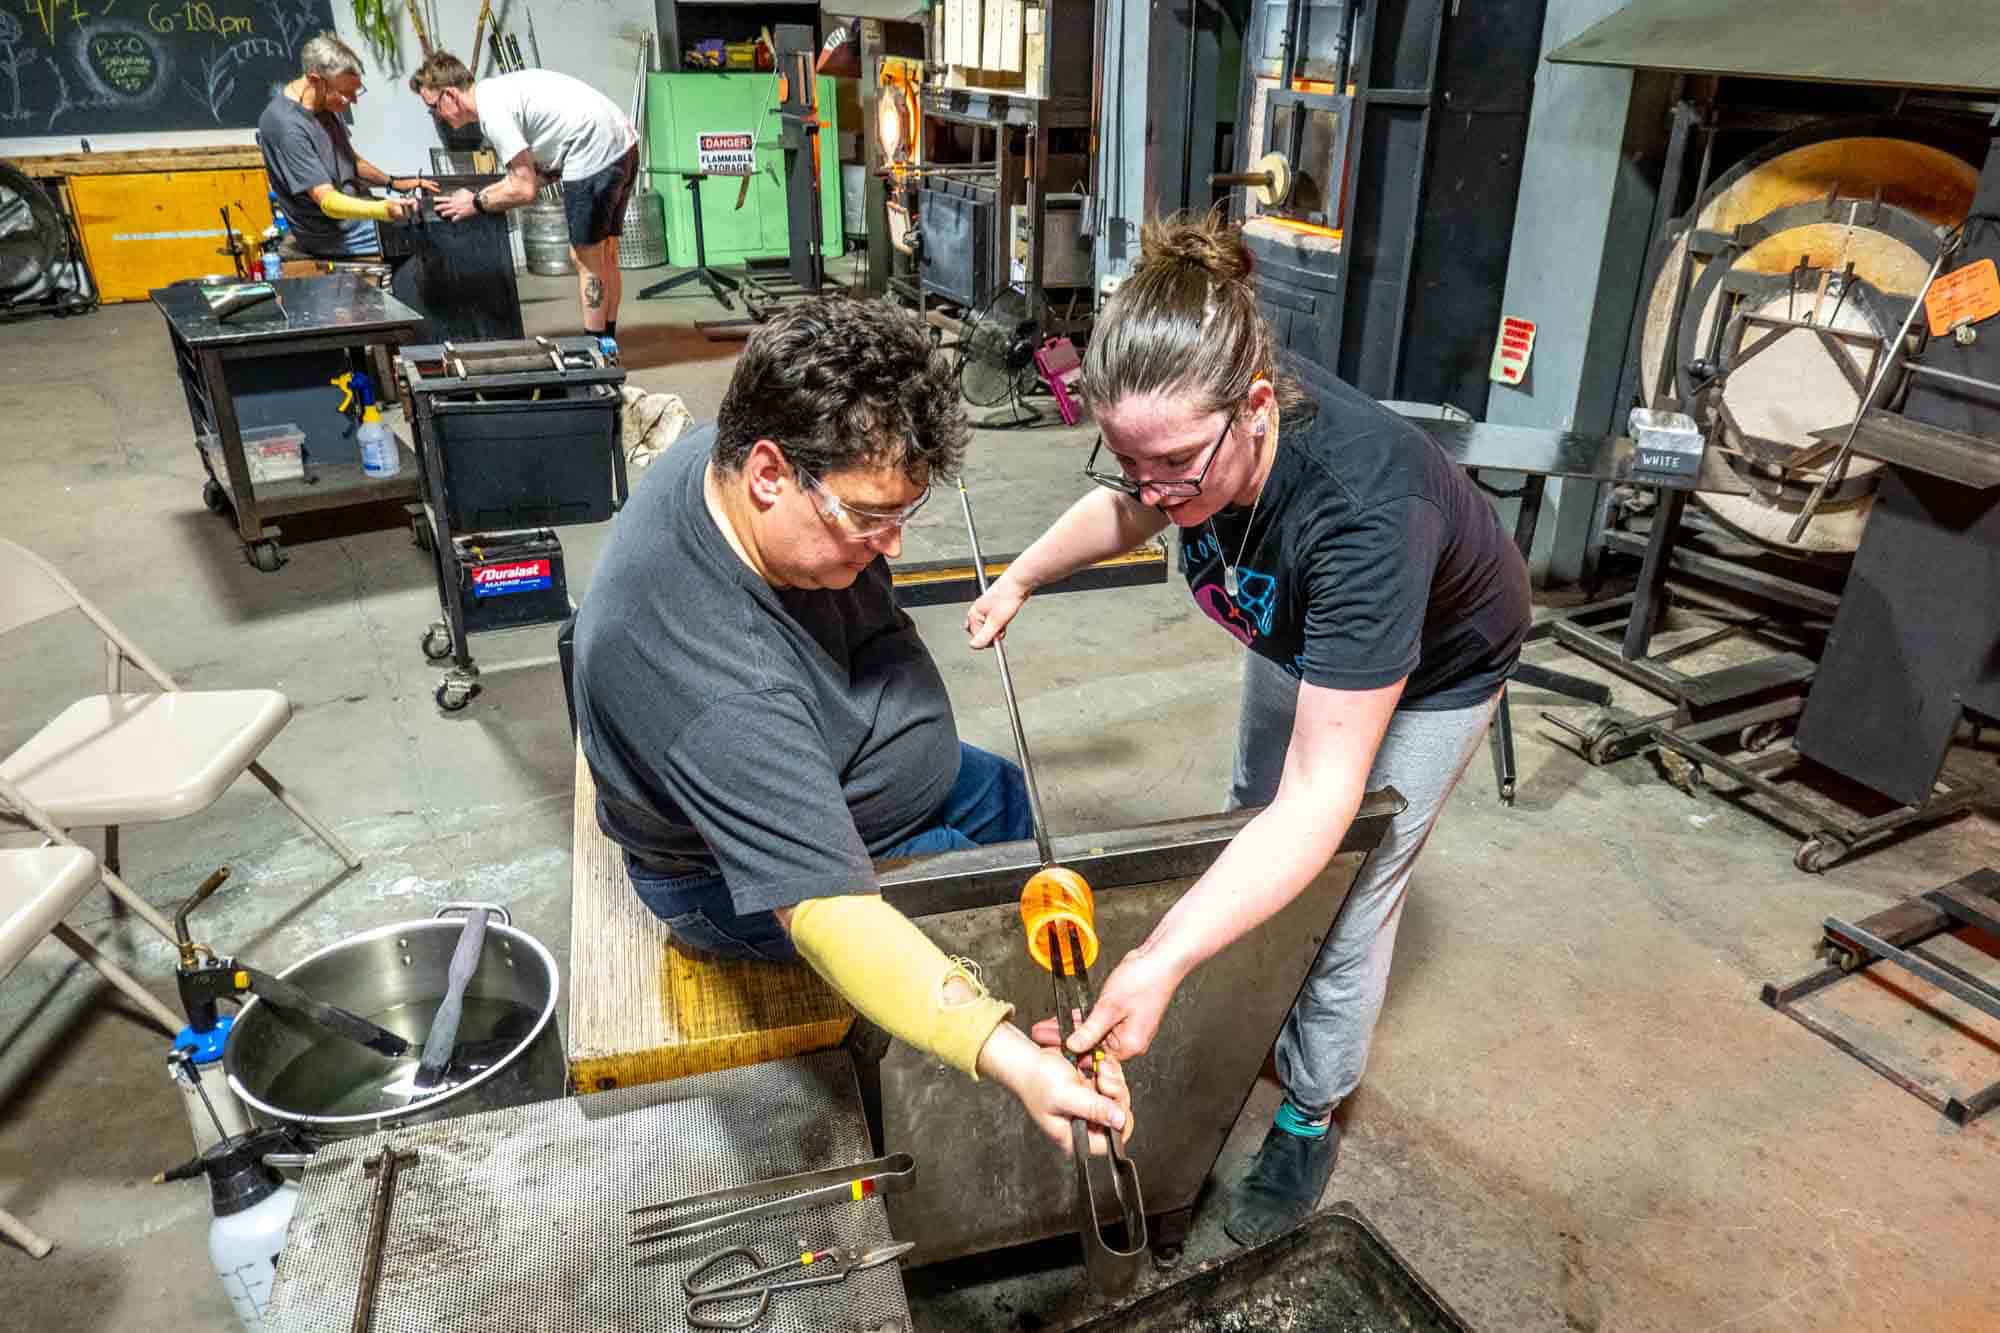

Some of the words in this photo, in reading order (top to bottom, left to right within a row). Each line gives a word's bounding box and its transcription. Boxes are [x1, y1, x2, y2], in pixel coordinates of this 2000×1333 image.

[706, 138, 747, 149] DANGER
[701, 154, 752, 163] FLAMMABLE
[1642, 453, 1680, 467] WHITE
[484, 564, 539, 581] Duralast
